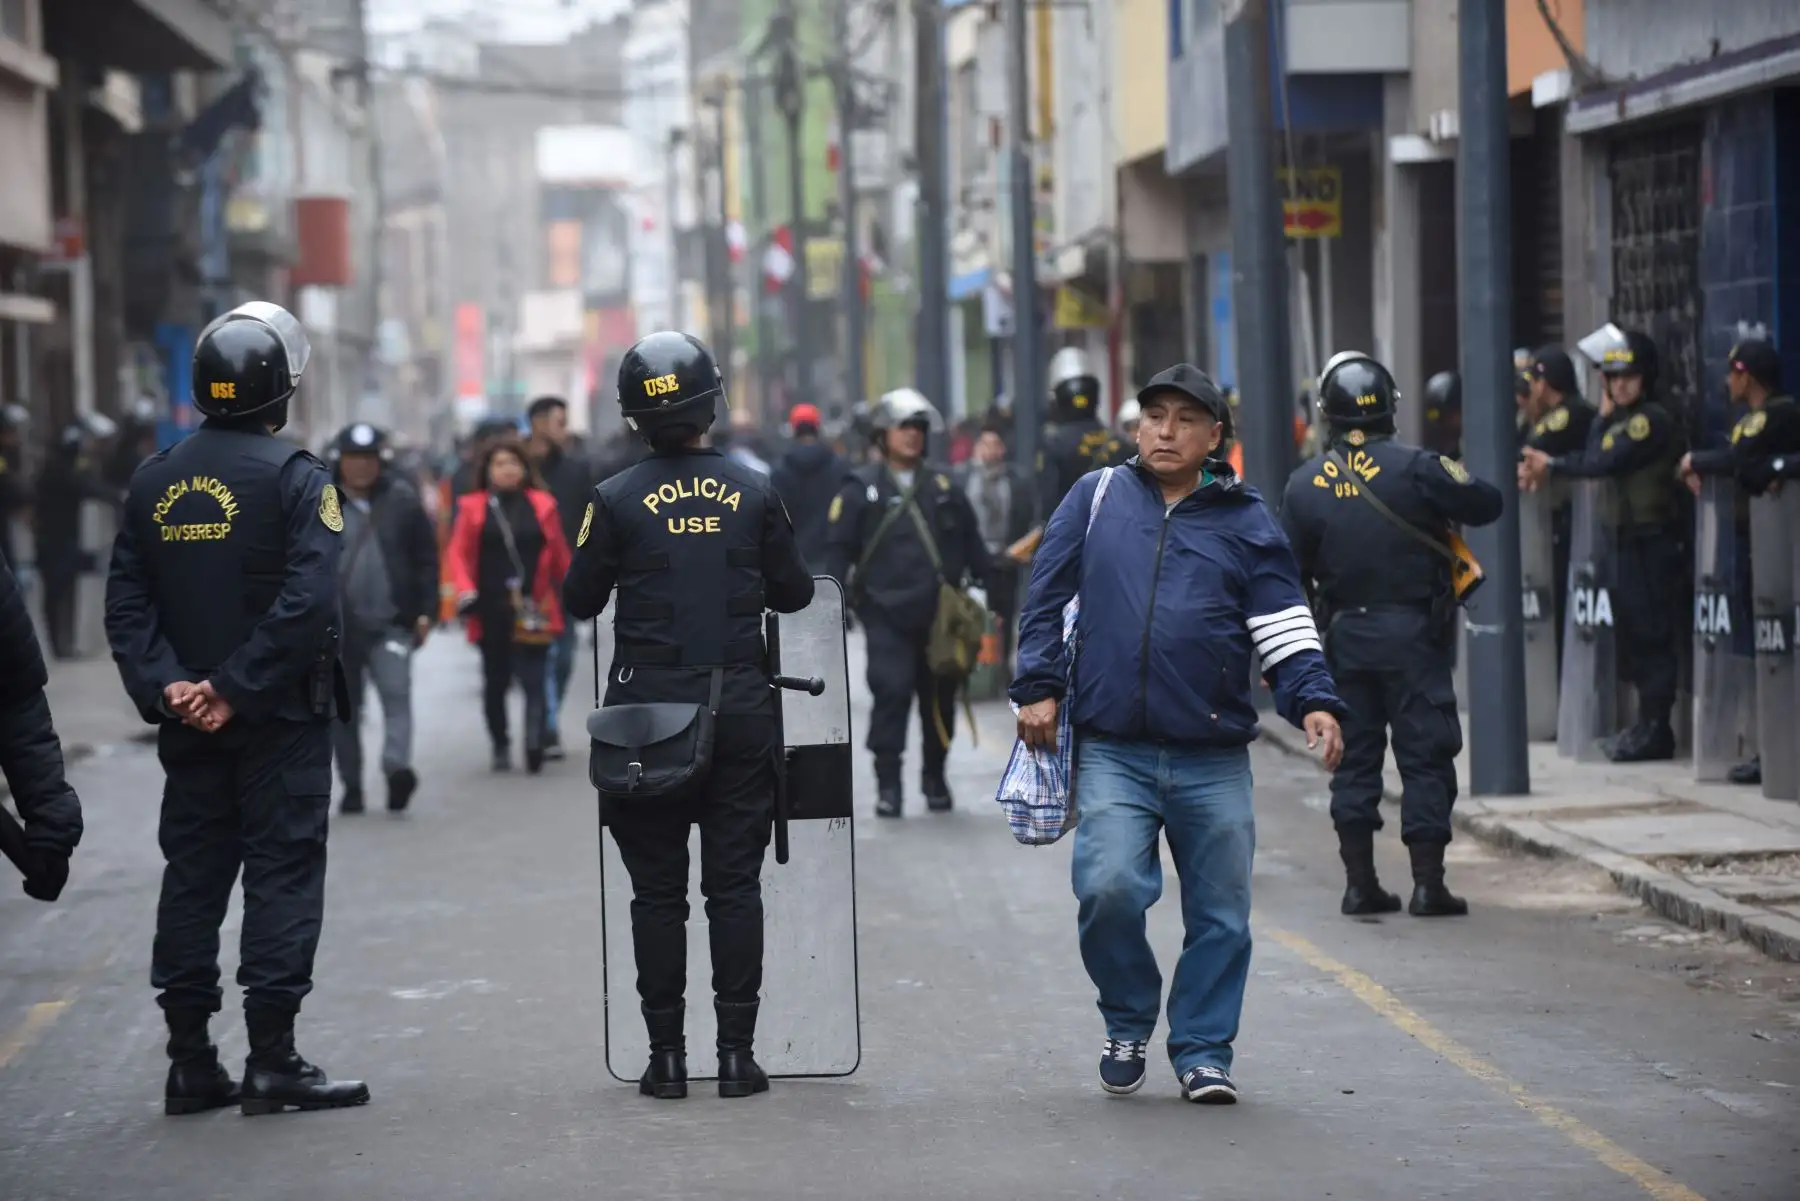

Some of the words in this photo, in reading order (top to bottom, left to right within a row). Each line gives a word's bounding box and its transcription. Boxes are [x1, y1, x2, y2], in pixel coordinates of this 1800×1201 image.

[211, 382, 236, 399] USE
[644, 373, 680, 397] USE
[1313, 450, 1380, 488] POICIA
[152, 479, 190, 524] POLICIA
[192, 476, 240, 522] NACIONAL
[643, 476, 742, 515] POLICIA
[161, 522, 232, 541] DIVSERESP
[667, 516, 721, 534] USE
